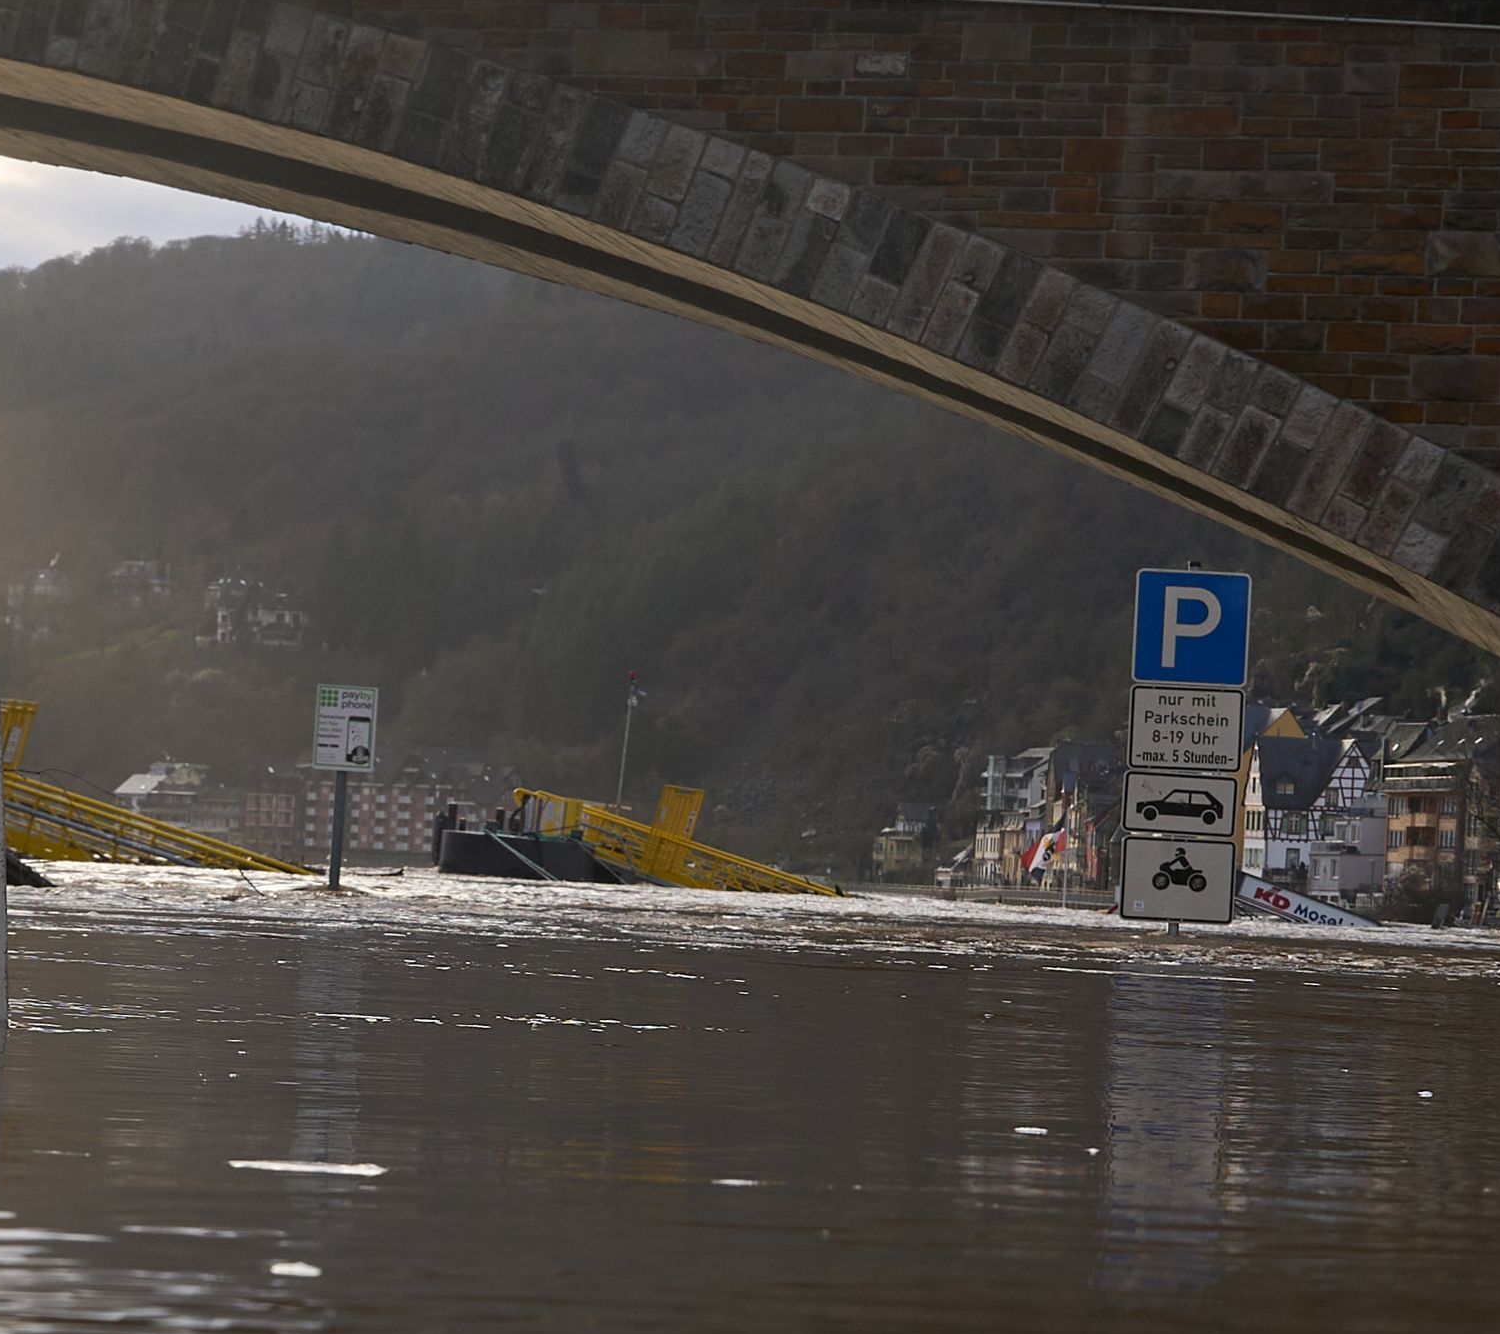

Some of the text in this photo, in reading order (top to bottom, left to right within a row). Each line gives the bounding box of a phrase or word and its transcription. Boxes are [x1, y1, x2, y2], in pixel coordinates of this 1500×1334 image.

[1161, 585, 1222, 668] P
[341, 700, 374, 710] phone
[1158, 694, 1217, 708] nur mit
[1144, 710, 1229, 727] Parkschein
[1152, 729, 1219, 745] 8-19 Uhr
[1172, 749, 1179, 763] 5
[1253, 887, 1291, 910] KD
